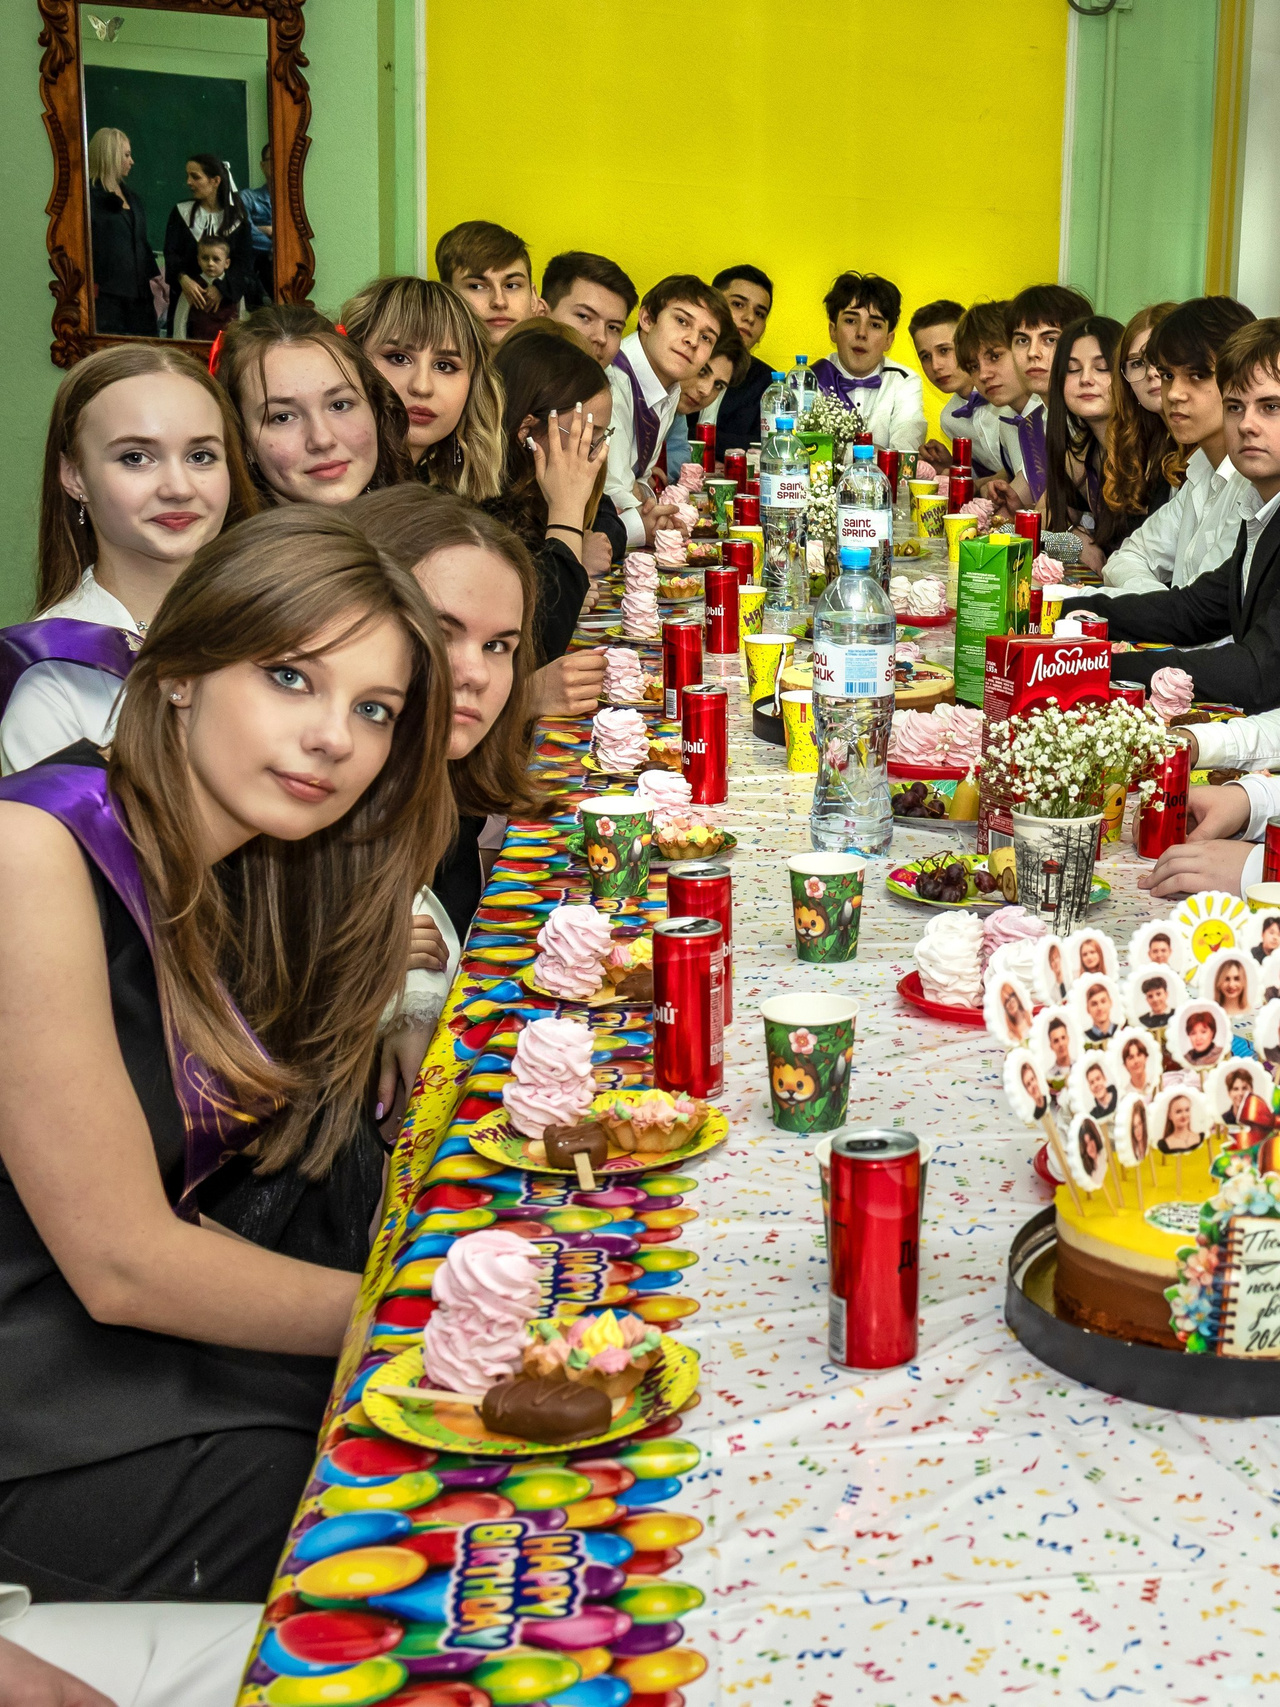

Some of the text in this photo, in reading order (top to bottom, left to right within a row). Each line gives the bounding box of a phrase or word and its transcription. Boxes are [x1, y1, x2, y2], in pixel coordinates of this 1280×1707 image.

[1026, 646, 1110, 687] Любимый
[452, 1522, 523, 1648] BIRTHDAY
[514, 1534, 579, 1617] HAPPY
